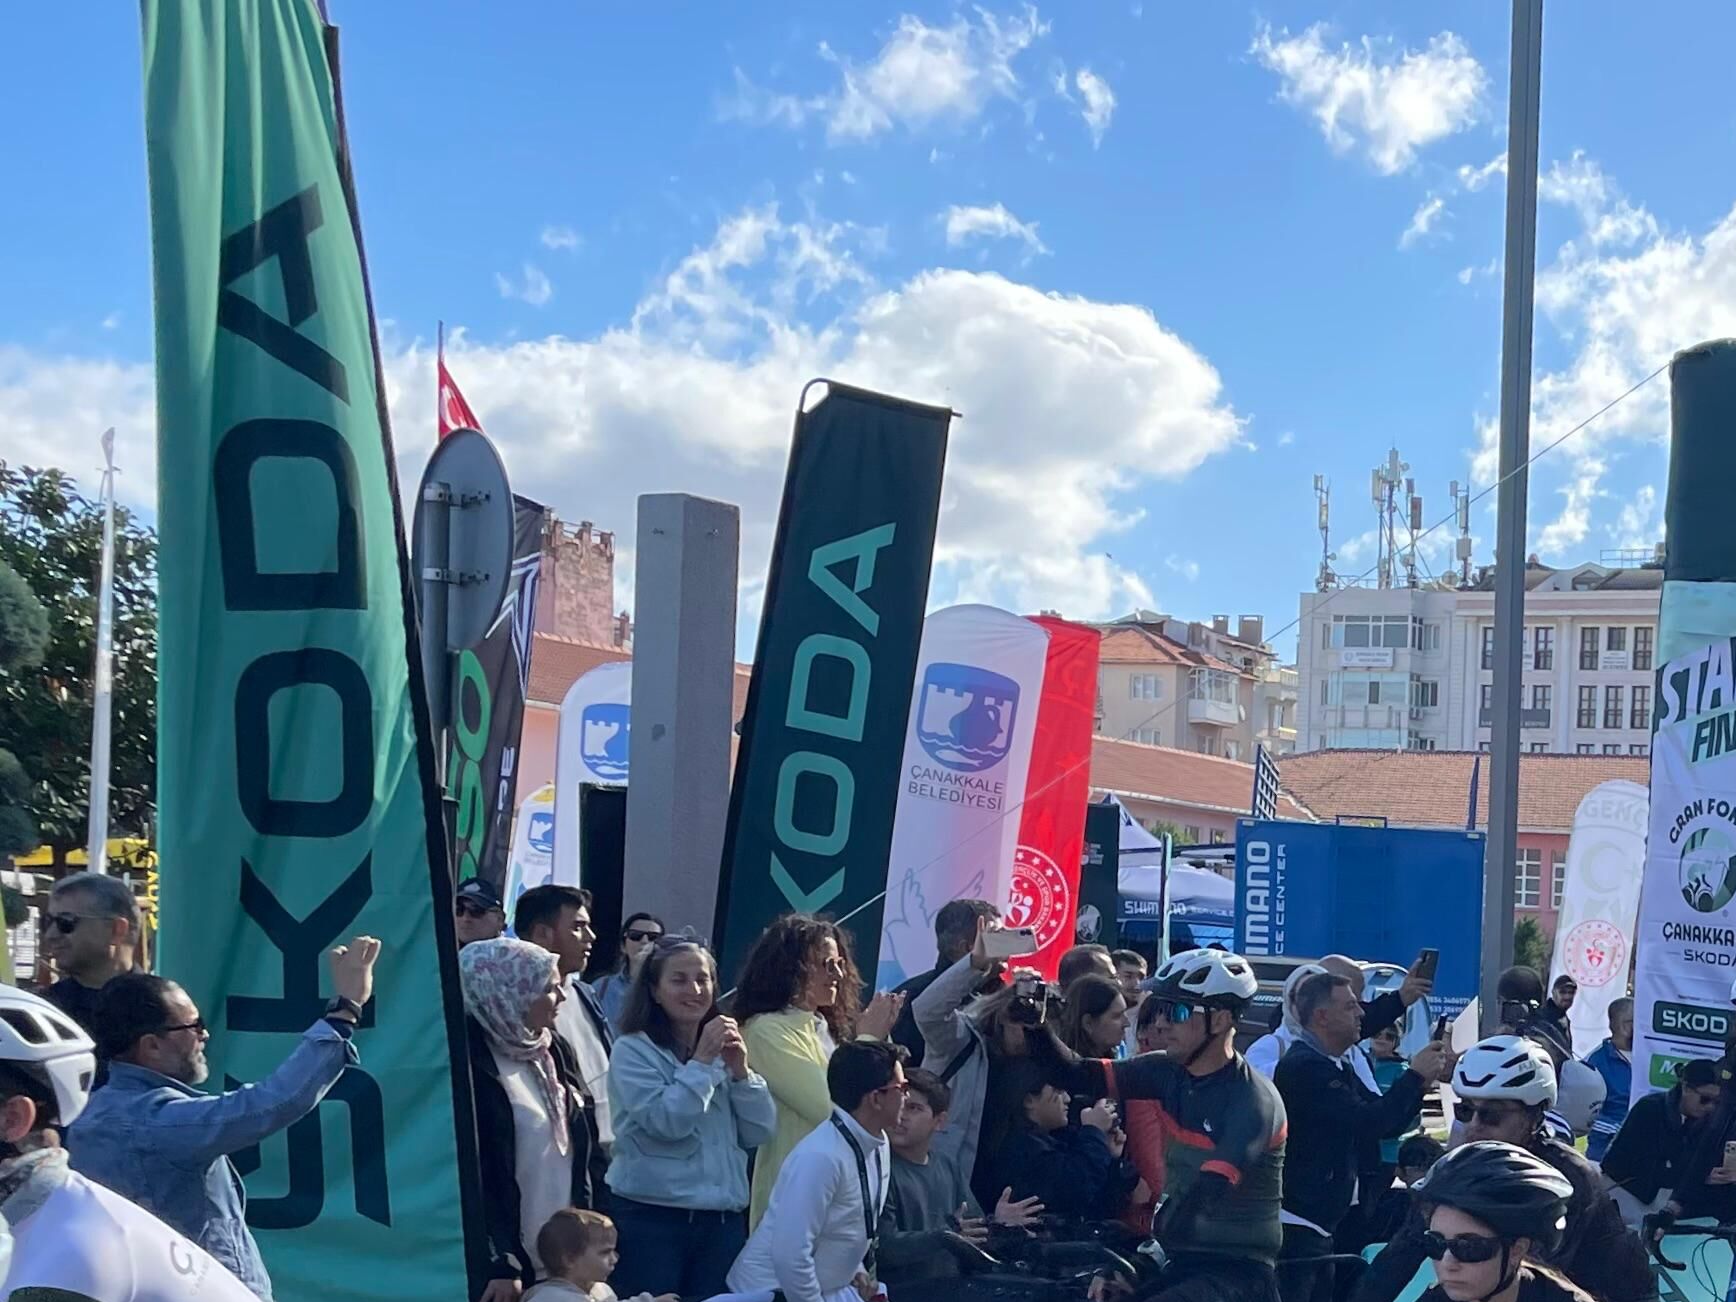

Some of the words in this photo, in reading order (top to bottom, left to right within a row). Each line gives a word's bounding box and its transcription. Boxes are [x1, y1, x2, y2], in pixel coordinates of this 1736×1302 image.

[907, 780, 1002, 811] BELEDİYESİ
[909, 764, 1004, 795] ÇANAKKALE
[1668, 798, 1704, 845] GRAN
[1275, 843, 1287, 926] CENTER
